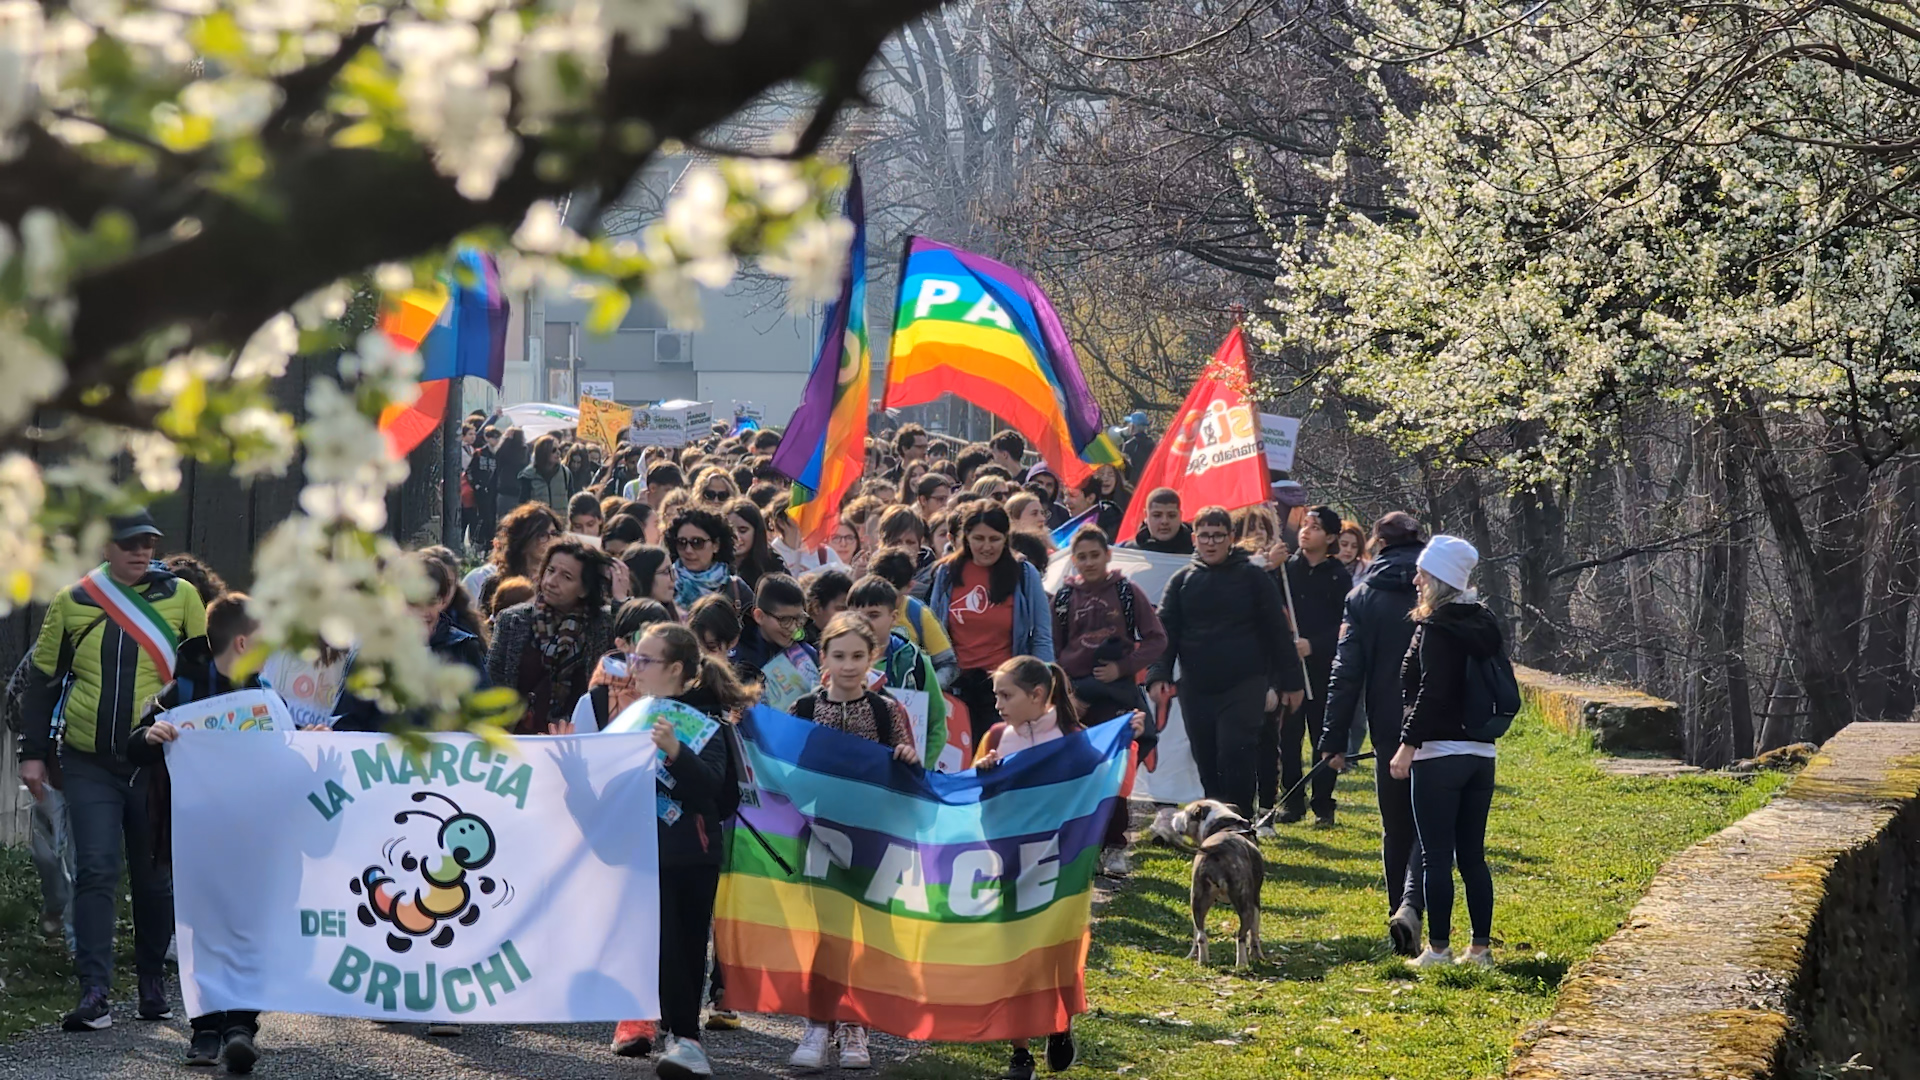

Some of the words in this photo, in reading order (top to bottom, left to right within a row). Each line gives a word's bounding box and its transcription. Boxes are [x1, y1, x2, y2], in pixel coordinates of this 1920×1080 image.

[307, 778, 355, 821] LA
[803, 824, 1060, 917] PACE
[328, 939, 533, 1014] BRUCHI
